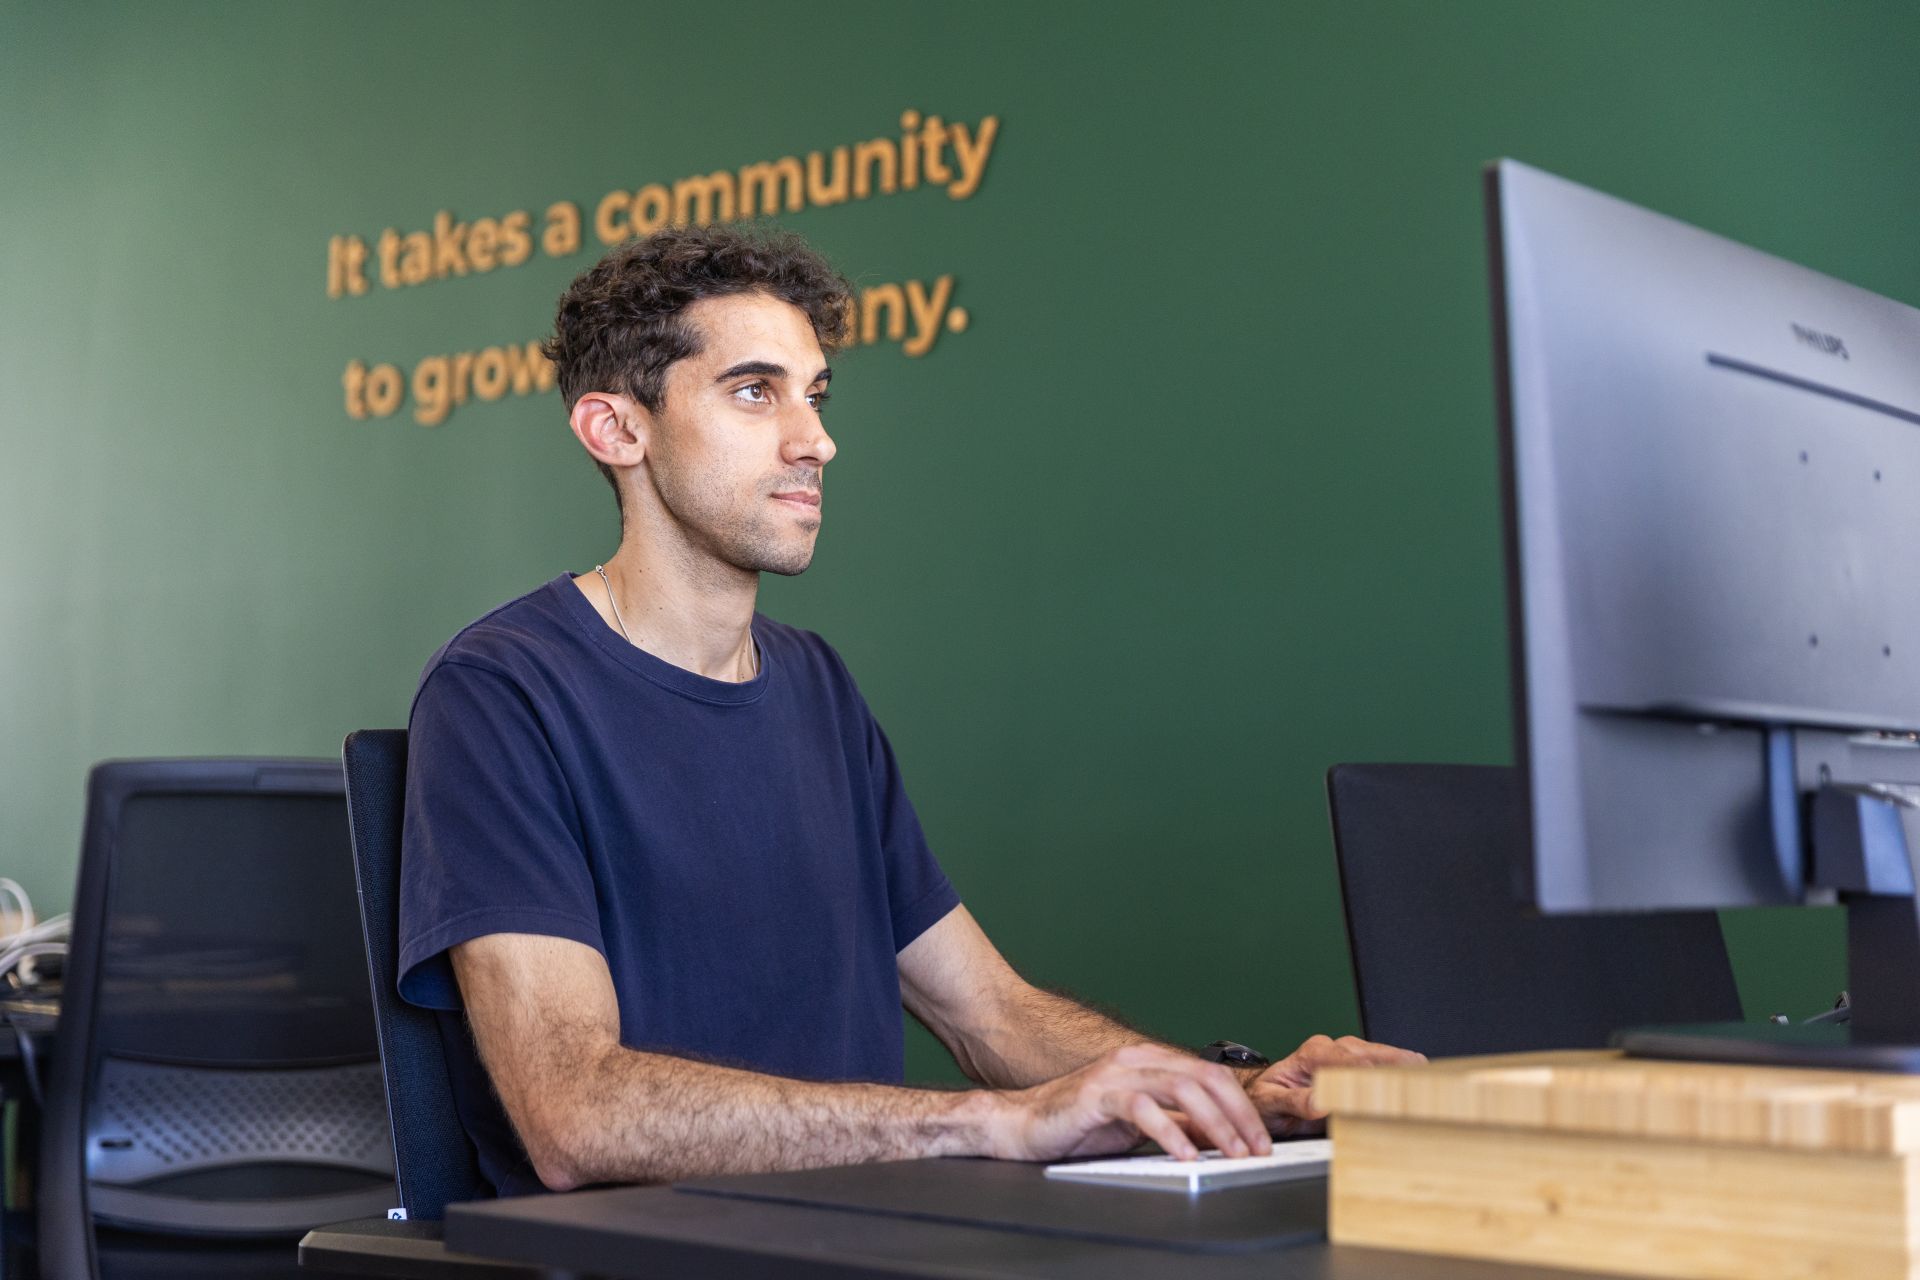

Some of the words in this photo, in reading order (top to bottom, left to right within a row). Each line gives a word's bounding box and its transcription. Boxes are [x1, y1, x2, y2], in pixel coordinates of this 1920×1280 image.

[327, 235, 368, 298] It
[377, 211, 532, 289] takes
[542, 201, 582, 257] a
[594, 110, 999, 245] community
[343, 359, 402, 420] to
[411, 339, 559, 425] grow
